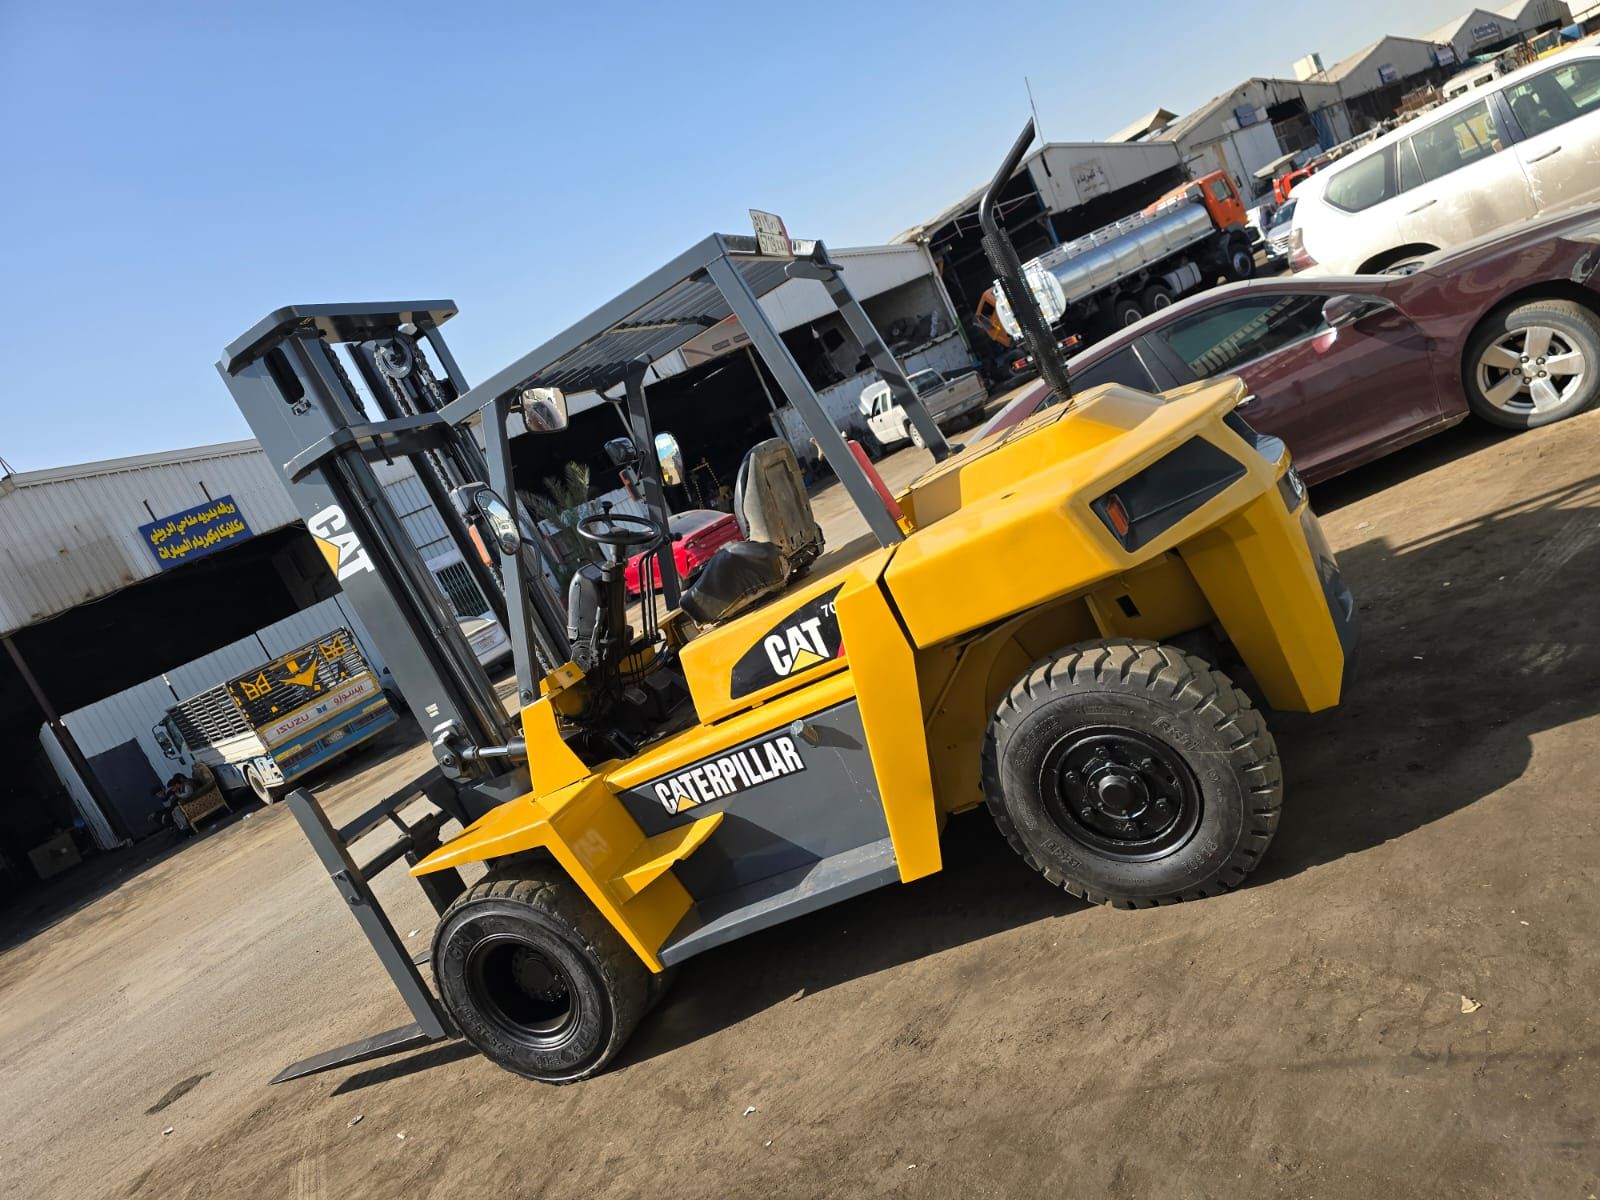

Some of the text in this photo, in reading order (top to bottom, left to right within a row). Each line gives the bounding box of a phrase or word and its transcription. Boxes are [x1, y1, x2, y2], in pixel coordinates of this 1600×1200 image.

[308, 504, 375, 582] CAT
[764, 616, 830, 676] CAT
[276, 713, 310, 735] ISUZU
[654, 736, 805, 815] CATERPILLAR
